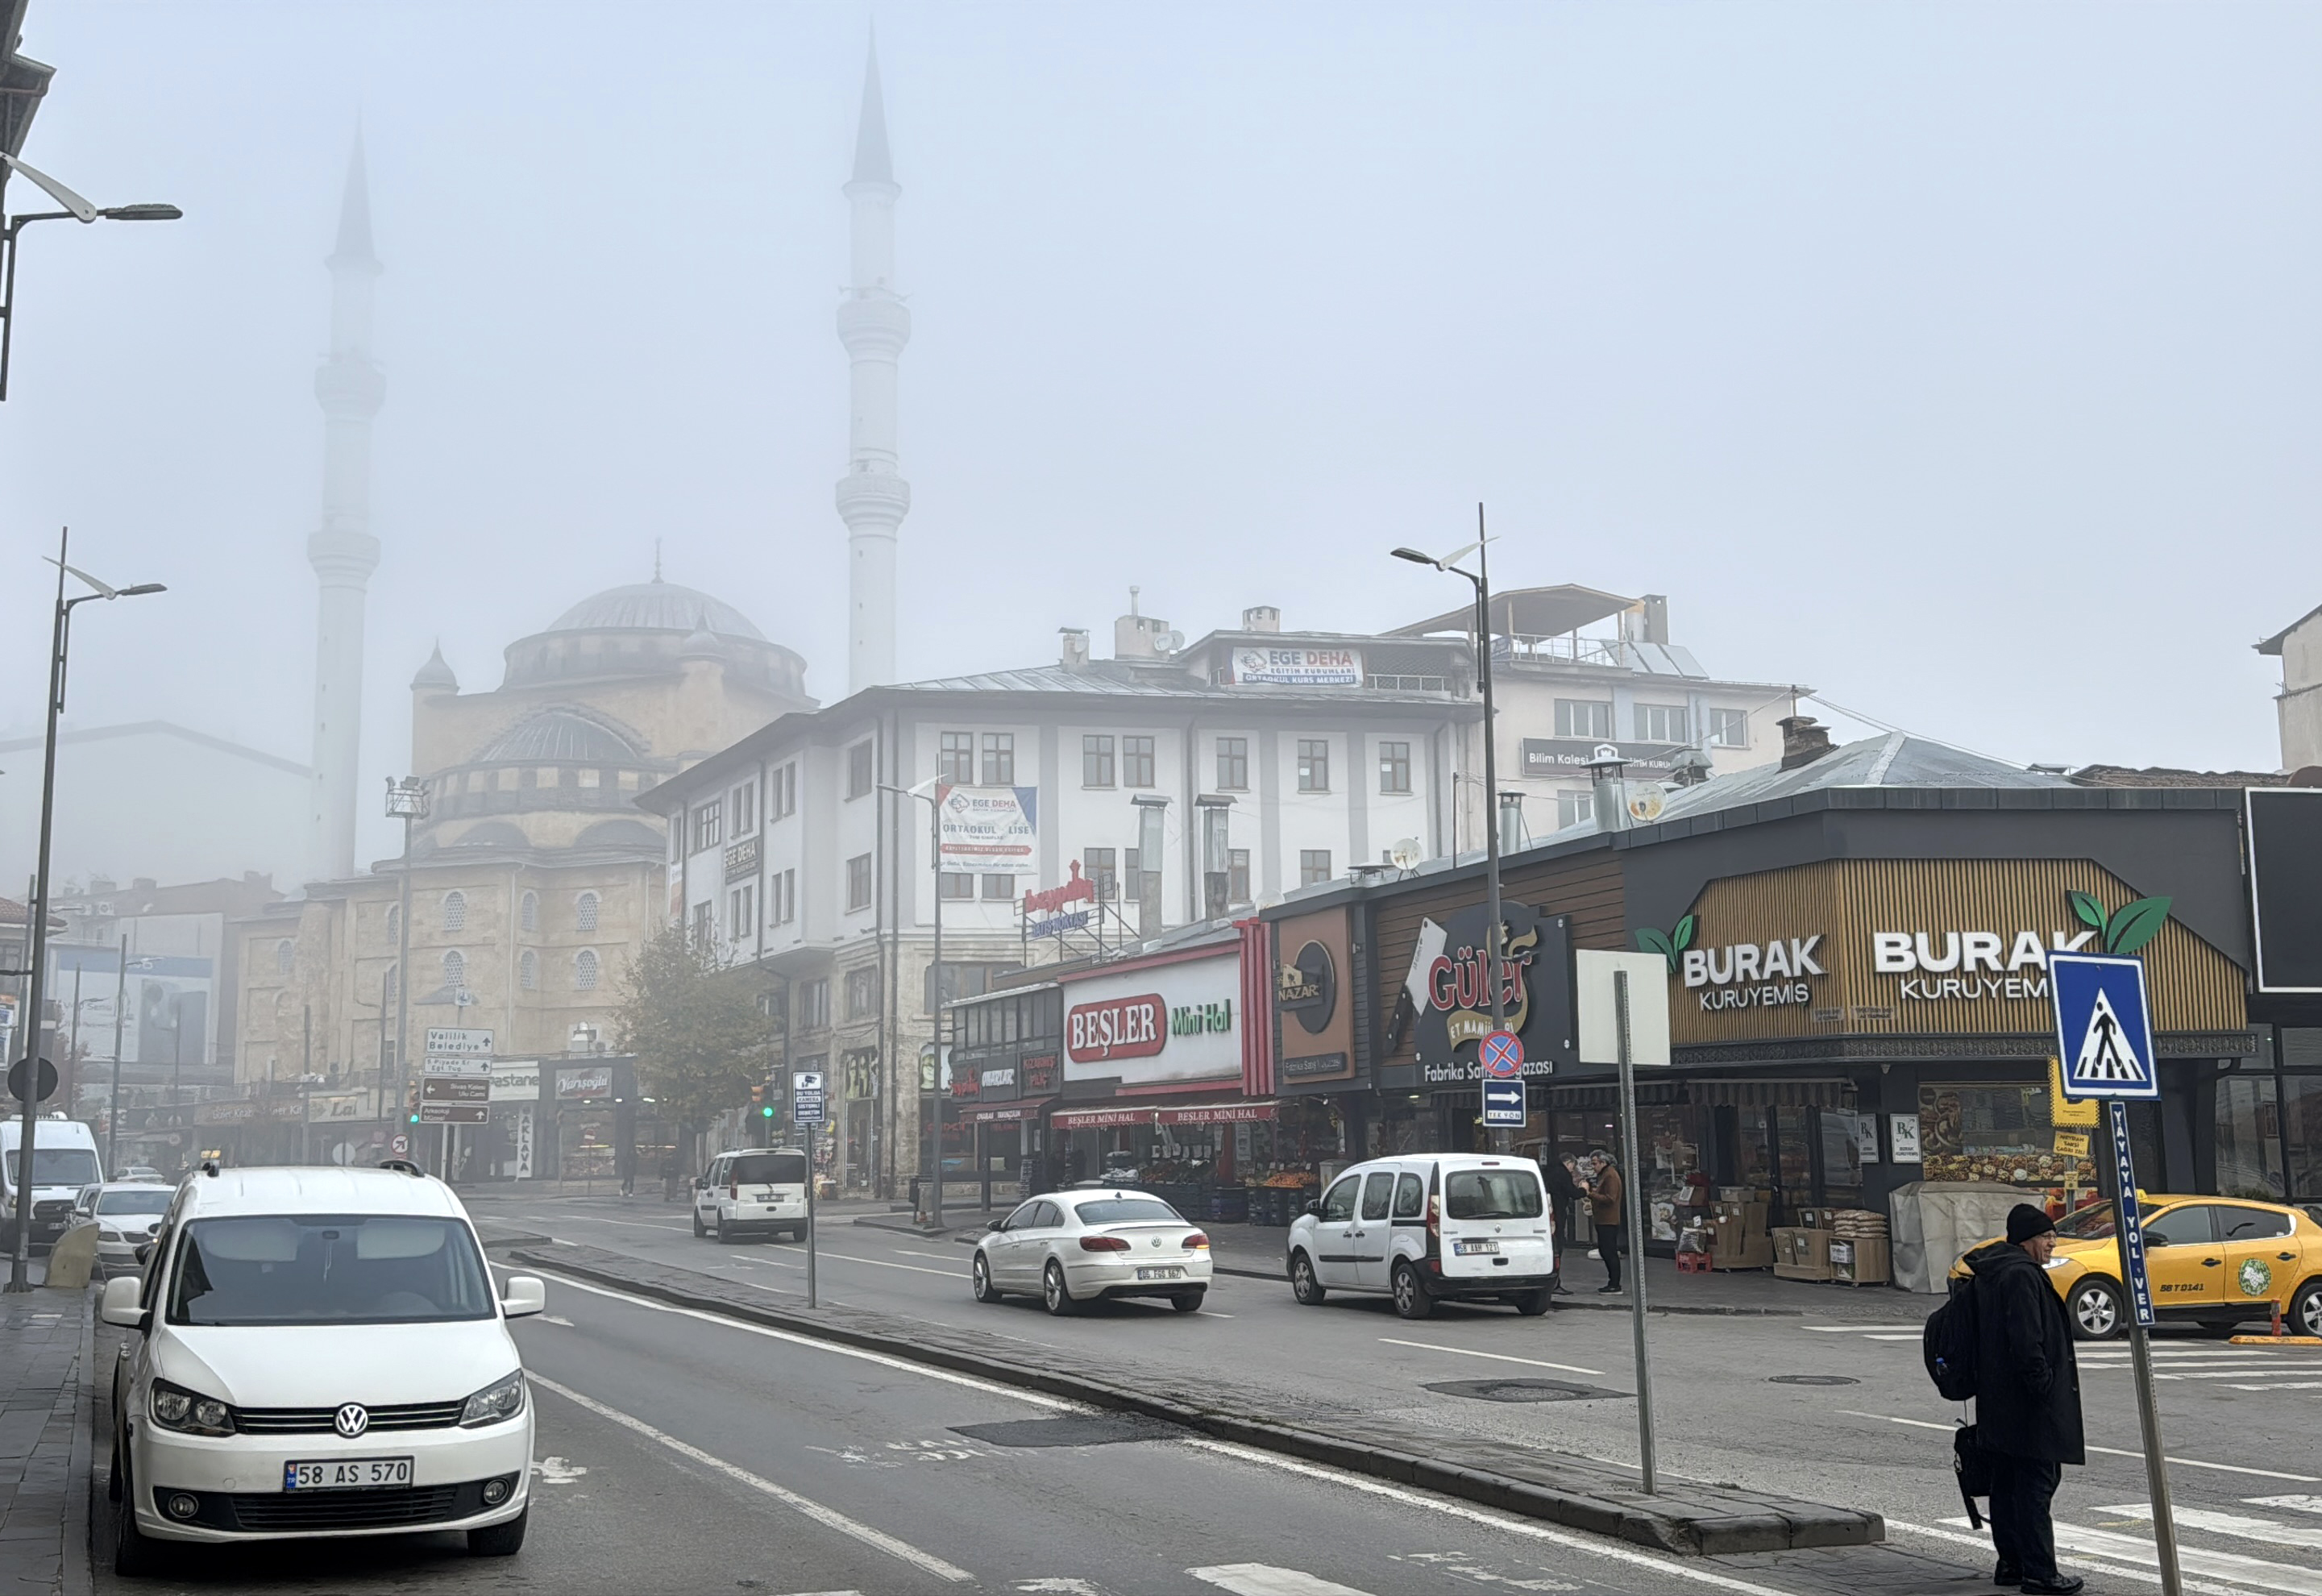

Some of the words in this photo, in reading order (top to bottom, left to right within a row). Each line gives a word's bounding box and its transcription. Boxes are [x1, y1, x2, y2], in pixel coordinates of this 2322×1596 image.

[1269, 650, 1301, 665] EGE
[1306, 650, 1353, 665] DEHA
[1245, 675, 1290, 684] ORTAOKUL
[1317, 675, 1353, 684] MERKEZİ
[1529, 753, 1555, 763] Bilim
[1557, 754, 1589, 766] Kalesi
[1649, 759, 1671, 768] KURU
[972, 799, 990, 807] EGE
[991, 800, 1016, 808] DEHA
[942, 824, 997, 834] ORTAOKUL
[1008, 822, 1029, 834] LİSE
[725, 848, 737, 867] EGE
[737, 841, 756, 862] DEHA
[1873, 930, 2098, 973] BURAK
[1683, 934, 1823, 988] BURAK
[1428, 945, 1532, 1011] Güler
[1278, 984, 1320, 1002] NAZAR
[1900, 978, 2049, 999] KURUYEM
[1171, 1005, 1202, 1036] Mini
[1203, 999, 1231, 1033] Hal
[431, 1032, 467, 1040] Valilik
[1071, 1003, 1157, 1057] BEŞLER
[1451, 1022, 1460, 1039] ET
[429, 1041, 480, 1051] Belediye
[1425, 1065, 1464, 1082] Fabrika
[1068, 1115, 1096, 1126] BEŞLER
[1097, 1112, 1117, 1124] MİNİ
[1118, 1112, 1136, 1123] HAL
[1178, 1112, 1211, 1123] BEŞLER
[1213, 1108, 1236, 1120] MİNİ
[1237, 1108, 1258, 1119] HAL
[2114, 1110, 2133, 1199] YAYAYA
[2126, 1216, 2140, 1259] YOL
[2134, 1277, 2150, 1321] VER
[298, 1466, 324, 1485] 58
[334, 1465, 359, 1483] AS
[371, 1463, 408, 1482] 570
